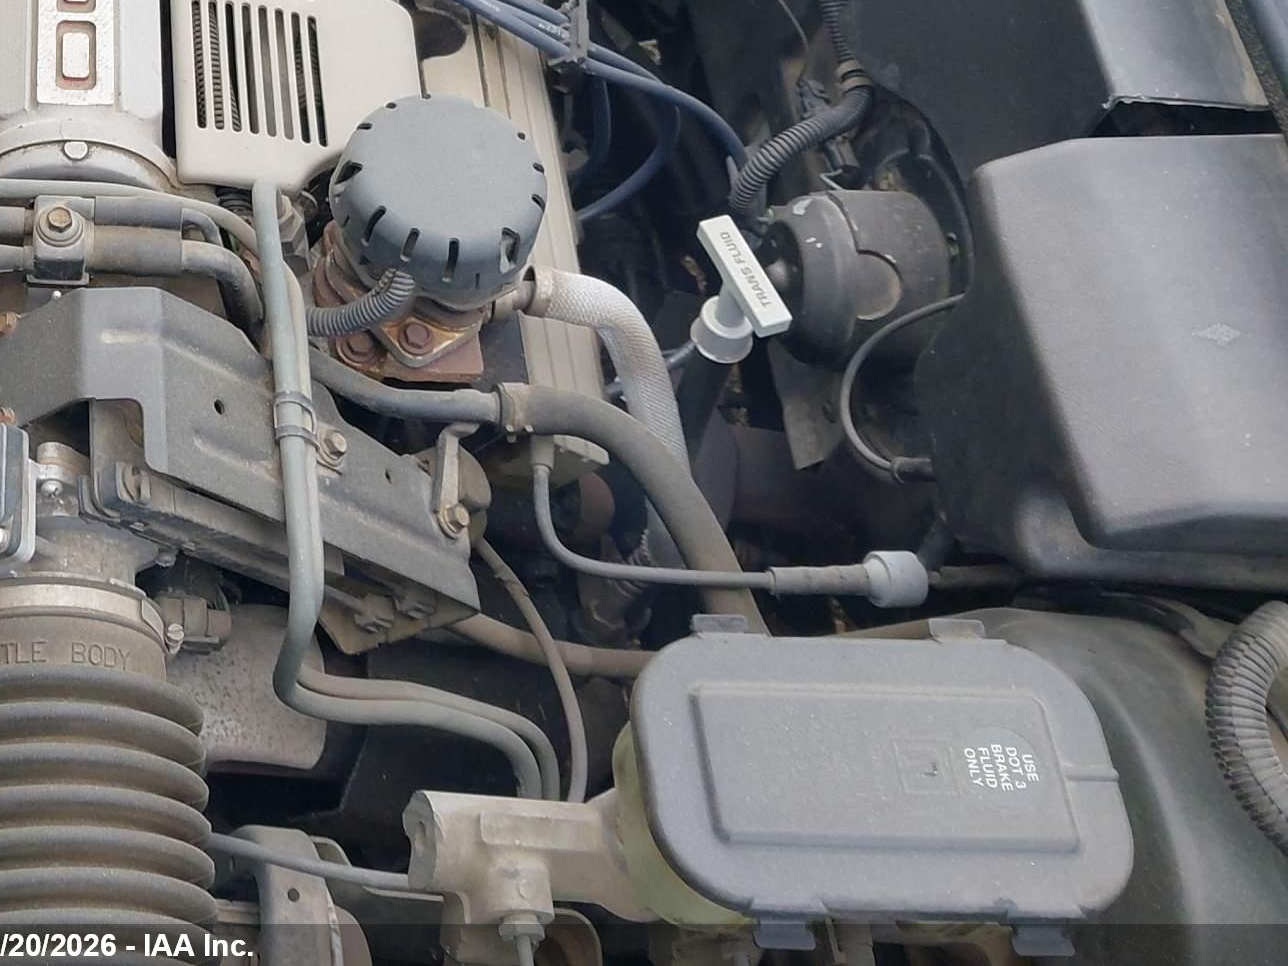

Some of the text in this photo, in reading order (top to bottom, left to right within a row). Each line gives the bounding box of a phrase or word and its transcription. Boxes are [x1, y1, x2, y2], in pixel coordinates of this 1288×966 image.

[719, 231, 772, 308] TRANS FLUID
[71, 641, 132, 672] BODY
[964, 747, 984, 787] ONLY
[977, 746, 998, 789] FLUID
[990, 743, 1014, 792] BRAKE
[1005, 746, 1027, 790] DOT 3
[1022, 754, 1040, 782] USE
